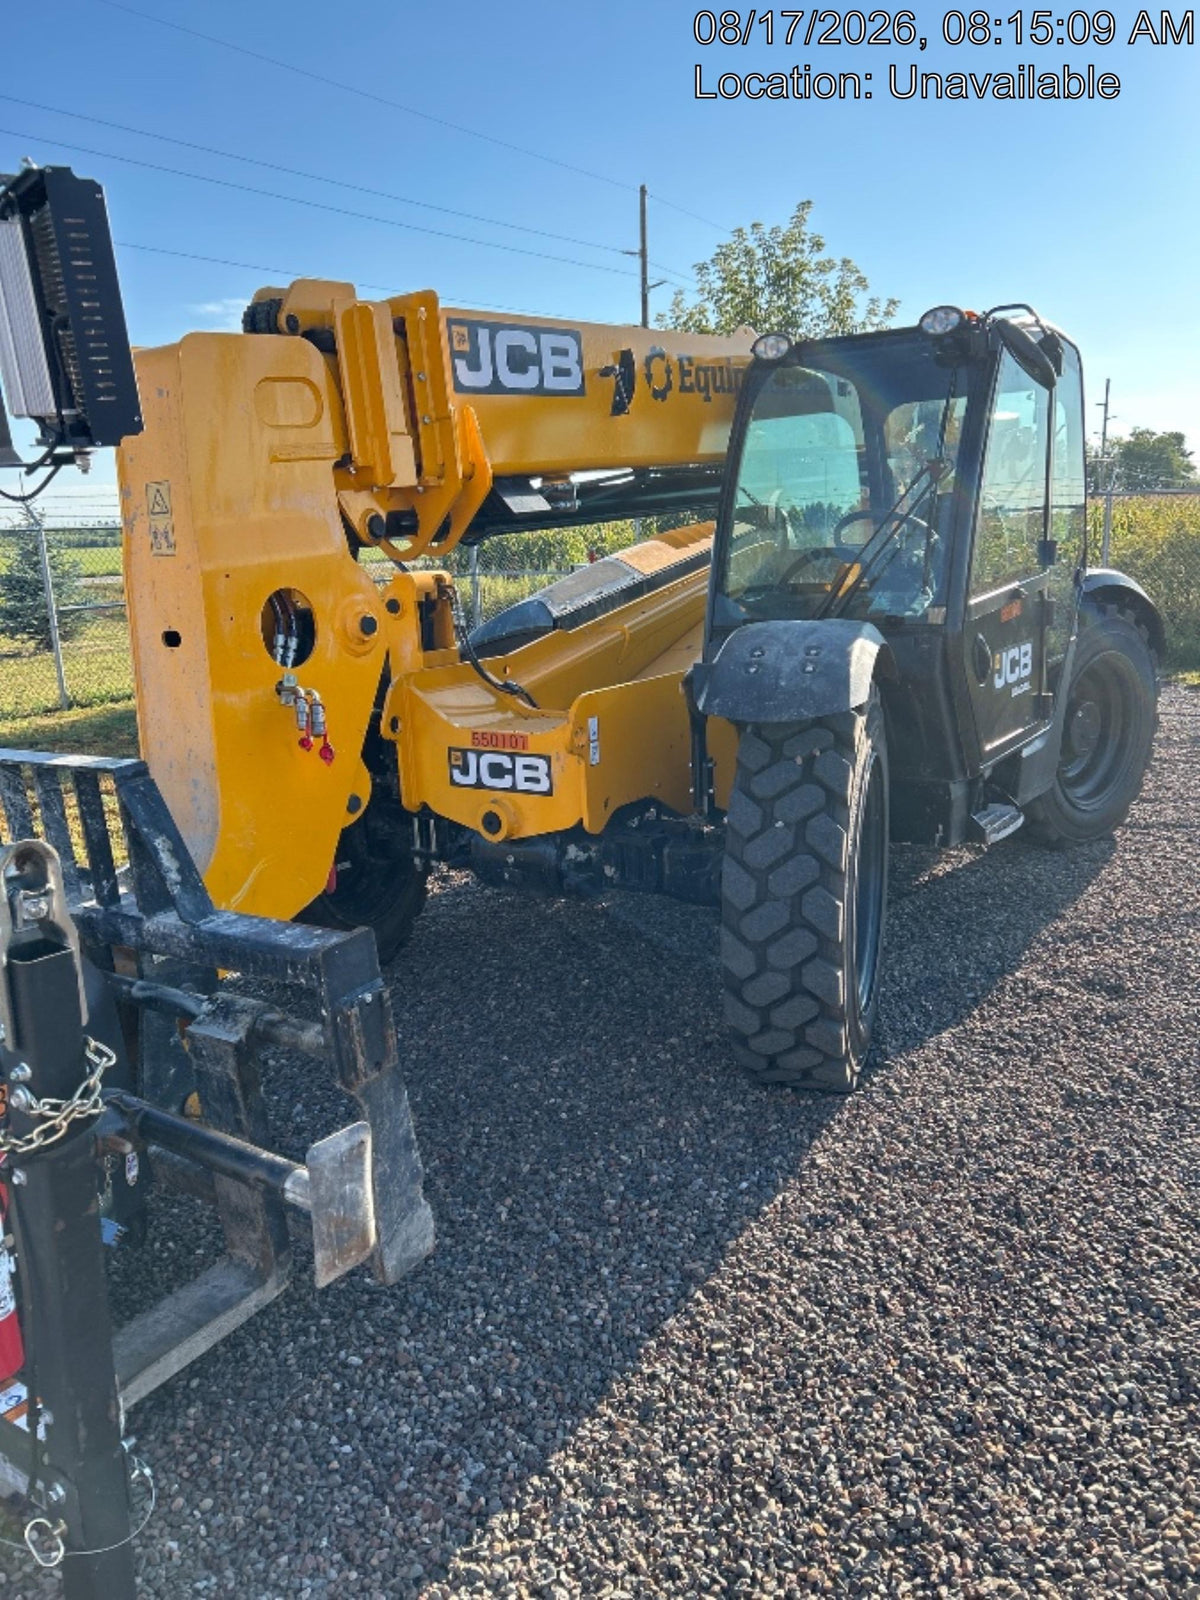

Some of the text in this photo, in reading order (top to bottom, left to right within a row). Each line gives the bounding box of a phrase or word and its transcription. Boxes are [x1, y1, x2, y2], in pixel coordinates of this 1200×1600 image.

[454, 328, 582, 390] JCB
[994, 643, 1032, 689] JCB
[452, 751, 551, 792] JCB
